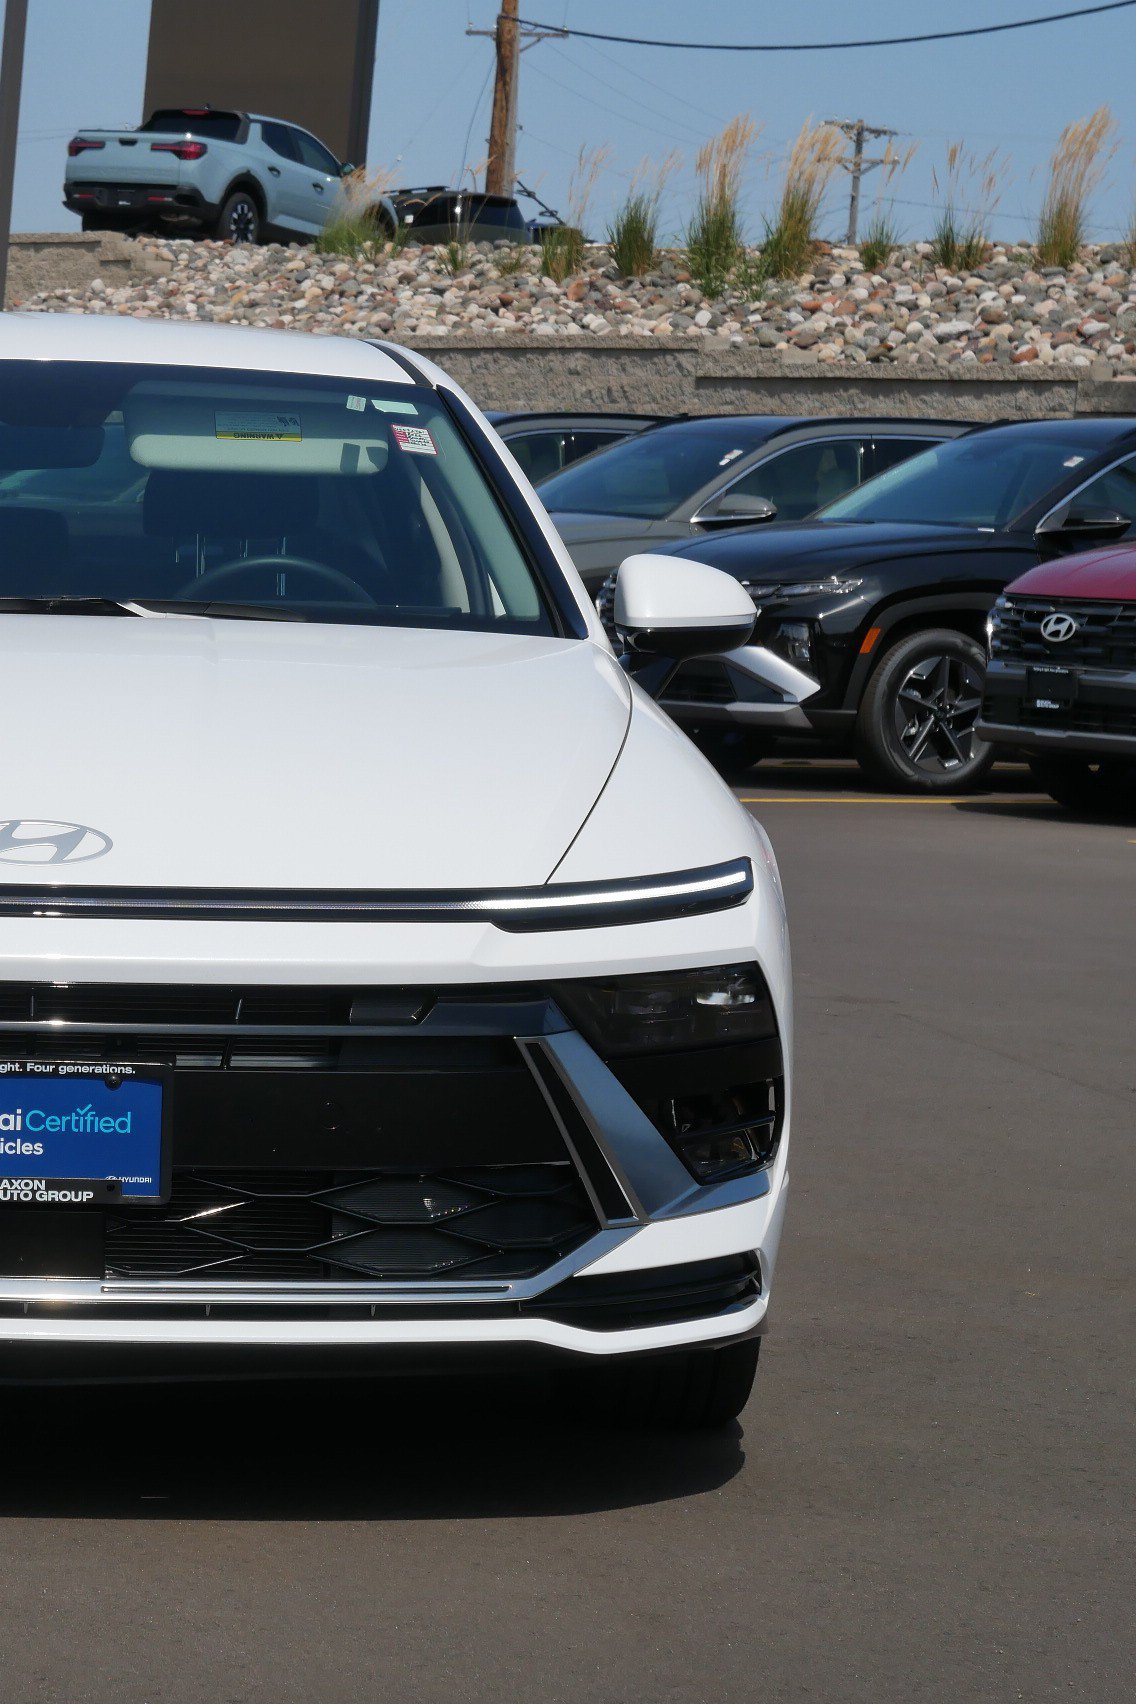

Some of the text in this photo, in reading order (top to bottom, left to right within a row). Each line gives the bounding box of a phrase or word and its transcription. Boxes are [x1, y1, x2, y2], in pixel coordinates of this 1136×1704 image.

[26, 1063, 55, 1072] Four
[59, 1065, 136, 1075] generations.
[25, 1104, 132, 1133] Certified
[119, 1176, 152, 1184] HYUNDAI
[35, 1191, 94, 1202] GROUP
